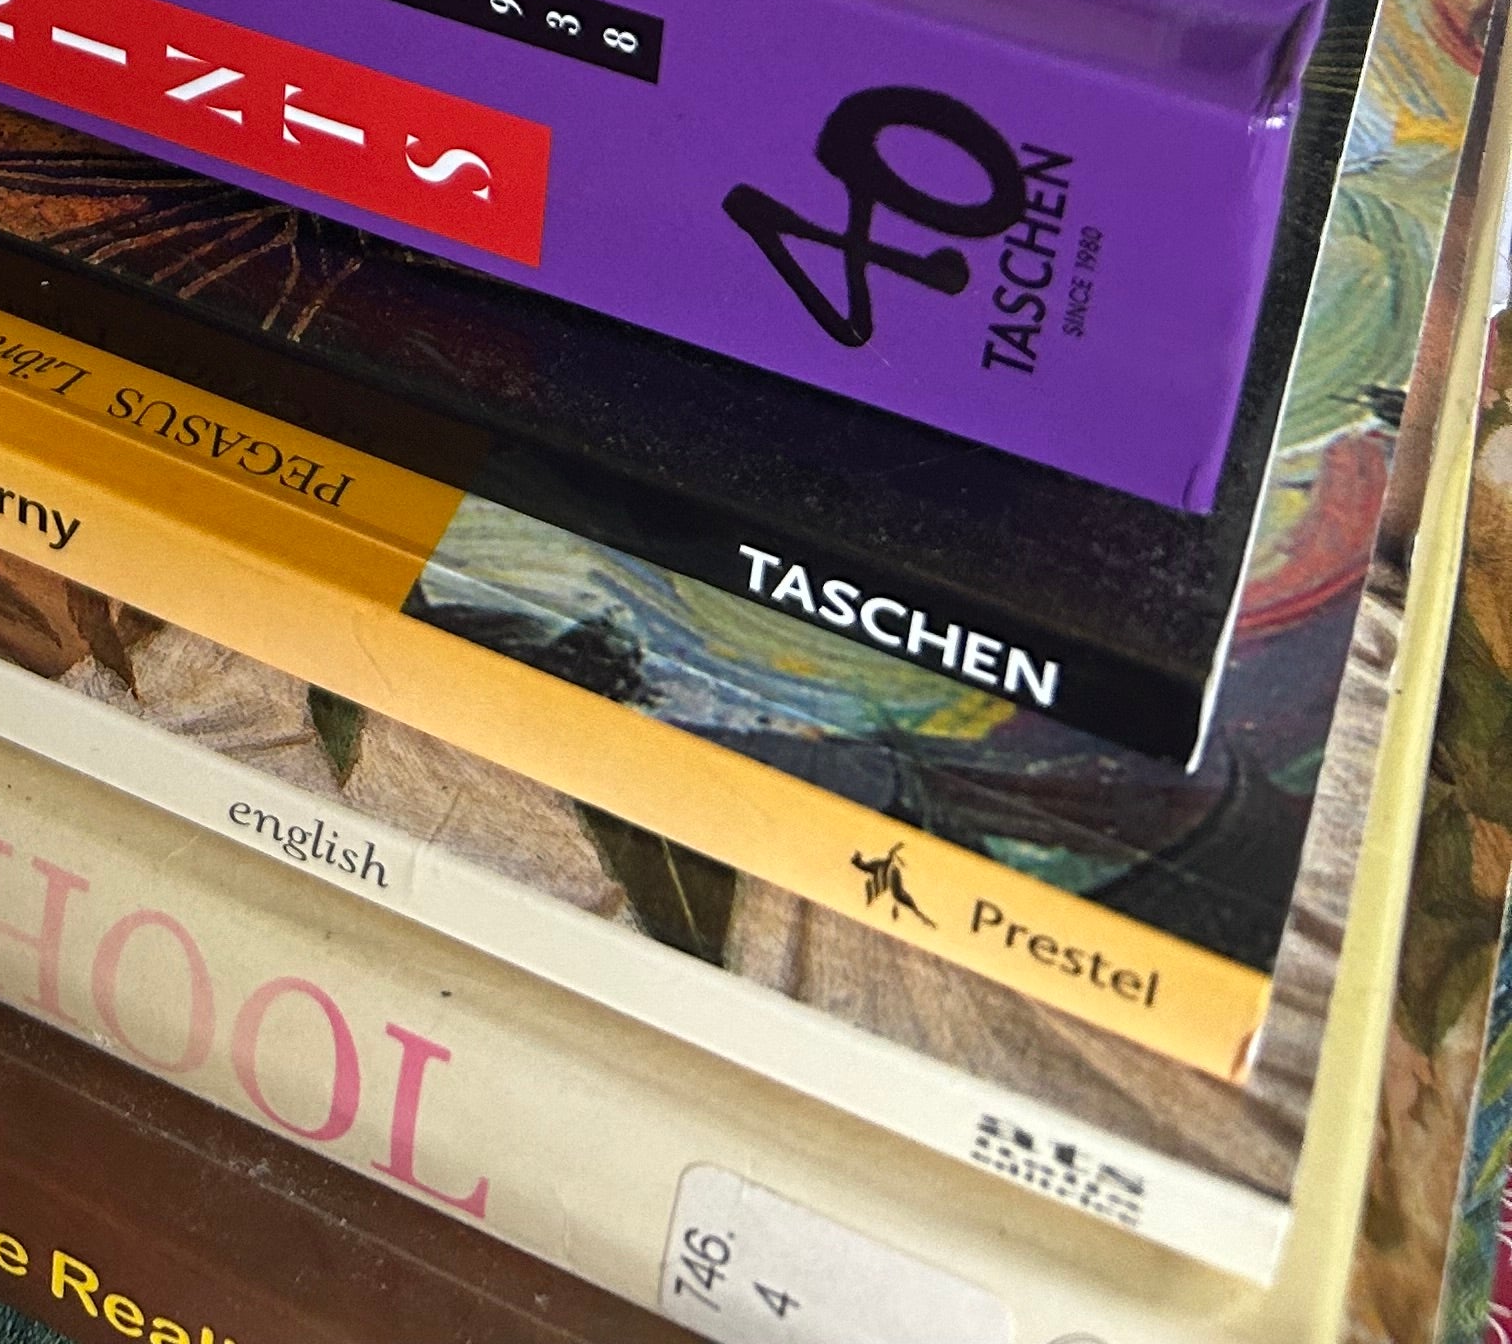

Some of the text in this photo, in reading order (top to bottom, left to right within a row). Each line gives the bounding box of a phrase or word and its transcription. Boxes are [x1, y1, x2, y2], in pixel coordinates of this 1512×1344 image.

[721, 85, 1026, 348] 40
[982, 143, 1073, 374] TASCHEN
[1062, 225, 1104, 339] SINCE 1980
[106, 386, 355, 508] PEGASUS
[738, 543, 1062, 709] TASCHEN
[228, 798, 390, 891] english
[969, 898, 1162, 1010] Prestel
